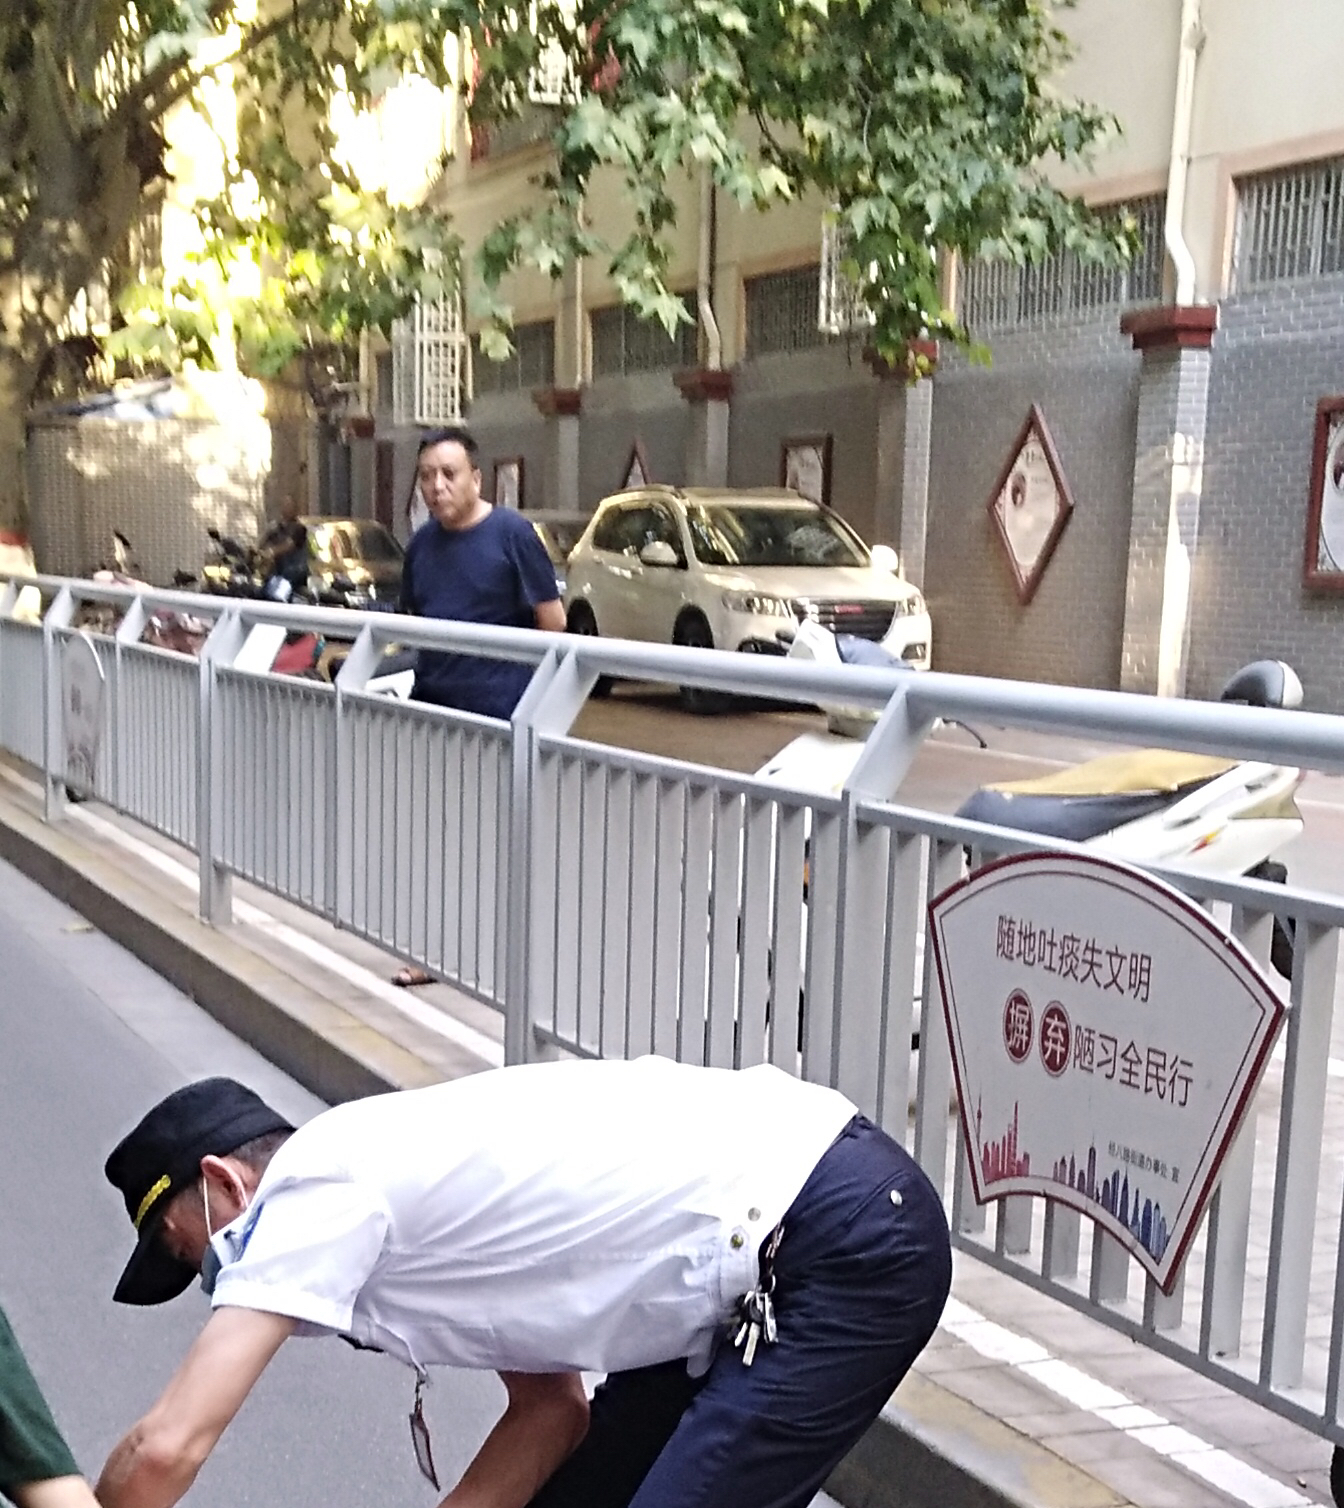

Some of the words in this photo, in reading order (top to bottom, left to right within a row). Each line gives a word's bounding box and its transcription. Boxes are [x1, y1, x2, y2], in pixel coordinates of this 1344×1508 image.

[996, 915, 1152, 1003] 随地吐痰失文明
